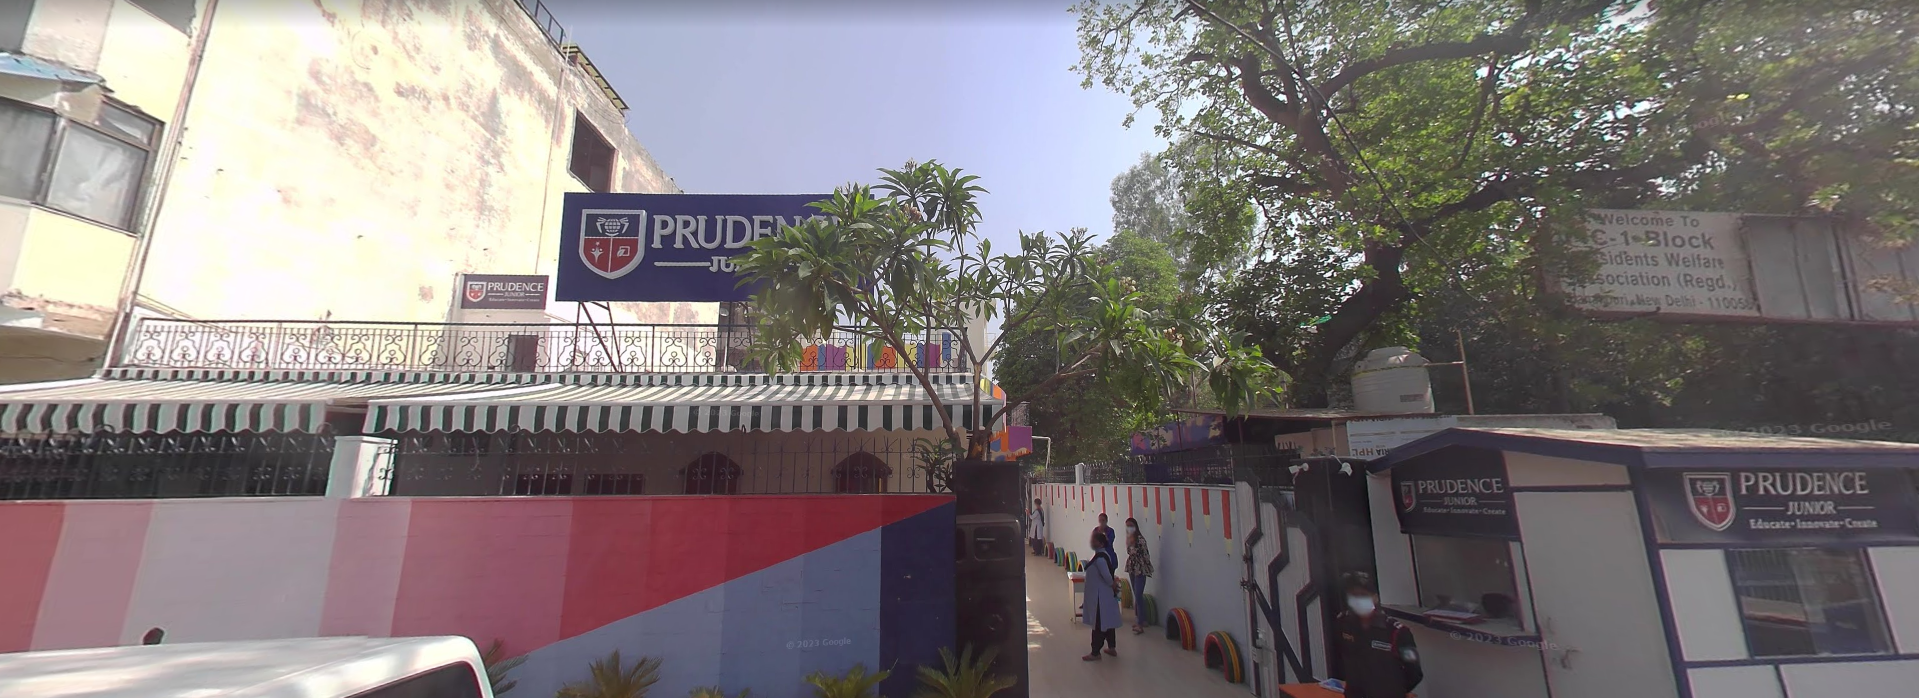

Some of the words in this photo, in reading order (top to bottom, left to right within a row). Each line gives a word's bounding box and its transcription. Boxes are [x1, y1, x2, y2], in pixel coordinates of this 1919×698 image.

[1600, 213, 1675, 227] Welcome
[1680, 215, 1700, 229] To
[1597, 250, 1660, 267] sidents
[1664, 252, 1725, 270] Welfare
[487, 282, 545, 292] PRUDENCE
[1596, 270, 1671, 288] sociation
[1677, 272, 1738, 292] (Regd.)
[1665, 294, 1696, 308] Delhi
[1417, 477, 1504, 495] PRUDENCE
[1739, 471, 1870, 496] PRUDENCE
[1443, 496, 1478, 506] JUNIOR
[1786, 501, 1838, 515] JUNIOR
